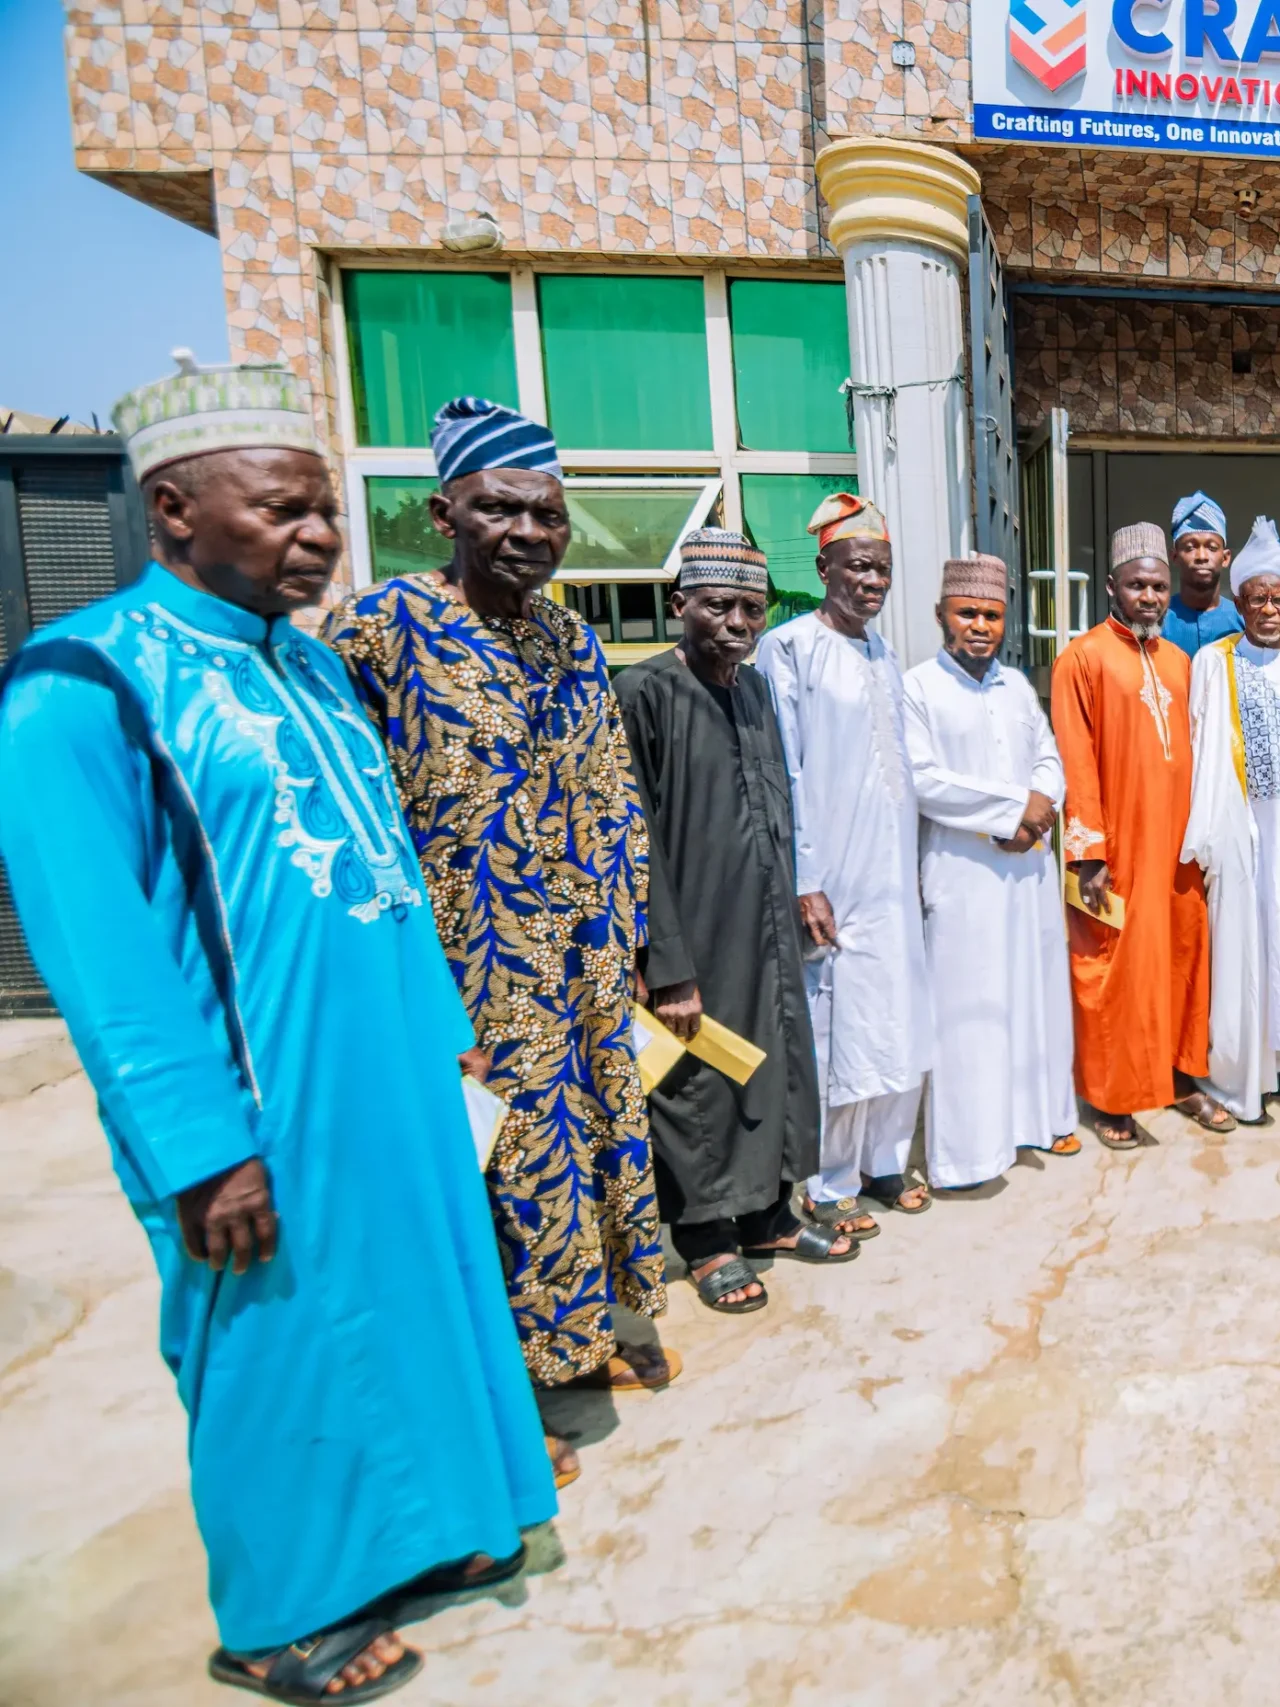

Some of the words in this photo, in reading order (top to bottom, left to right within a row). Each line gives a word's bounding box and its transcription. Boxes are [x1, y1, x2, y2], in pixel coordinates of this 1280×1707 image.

[991, 112, 1074, 138] Crafting
[1080, 117, 1160, 142] Futures,
[1166, 123, 1204, 142] One
